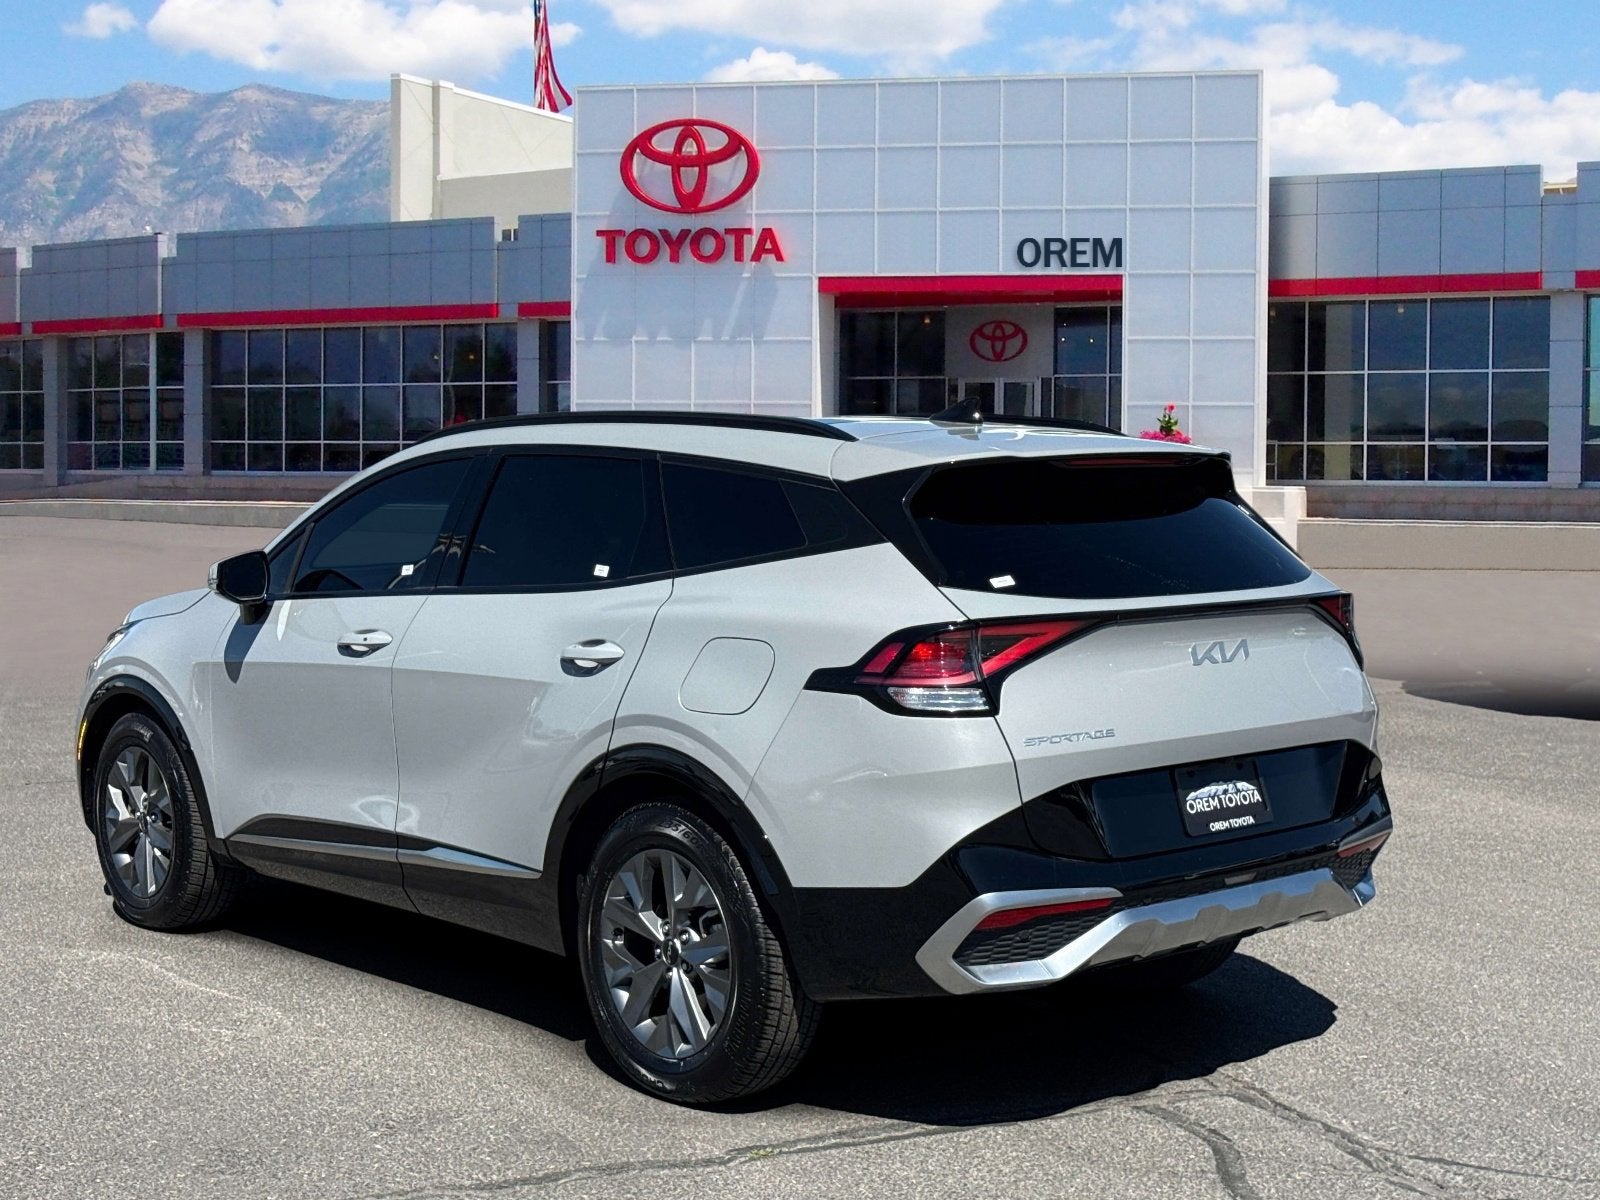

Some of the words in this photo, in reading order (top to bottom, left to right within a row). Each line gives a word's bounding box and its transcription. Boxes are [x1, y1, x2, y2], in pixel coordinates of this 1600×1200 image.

[596, 227, 785, 264] TOYOTA
[1017, 237, 1122, 268] OREM
[1189, 639, 1250, 666] KIA
[1023, 728, 1116, 747] SPORTAGE
[1186, 797, 1221, 814] OREM
[1220, 789, 1262, 808] TOYOTA
[1209, 821, 1231, 832] OREM
[1229, 815, 1256, 829] TOYOTA
